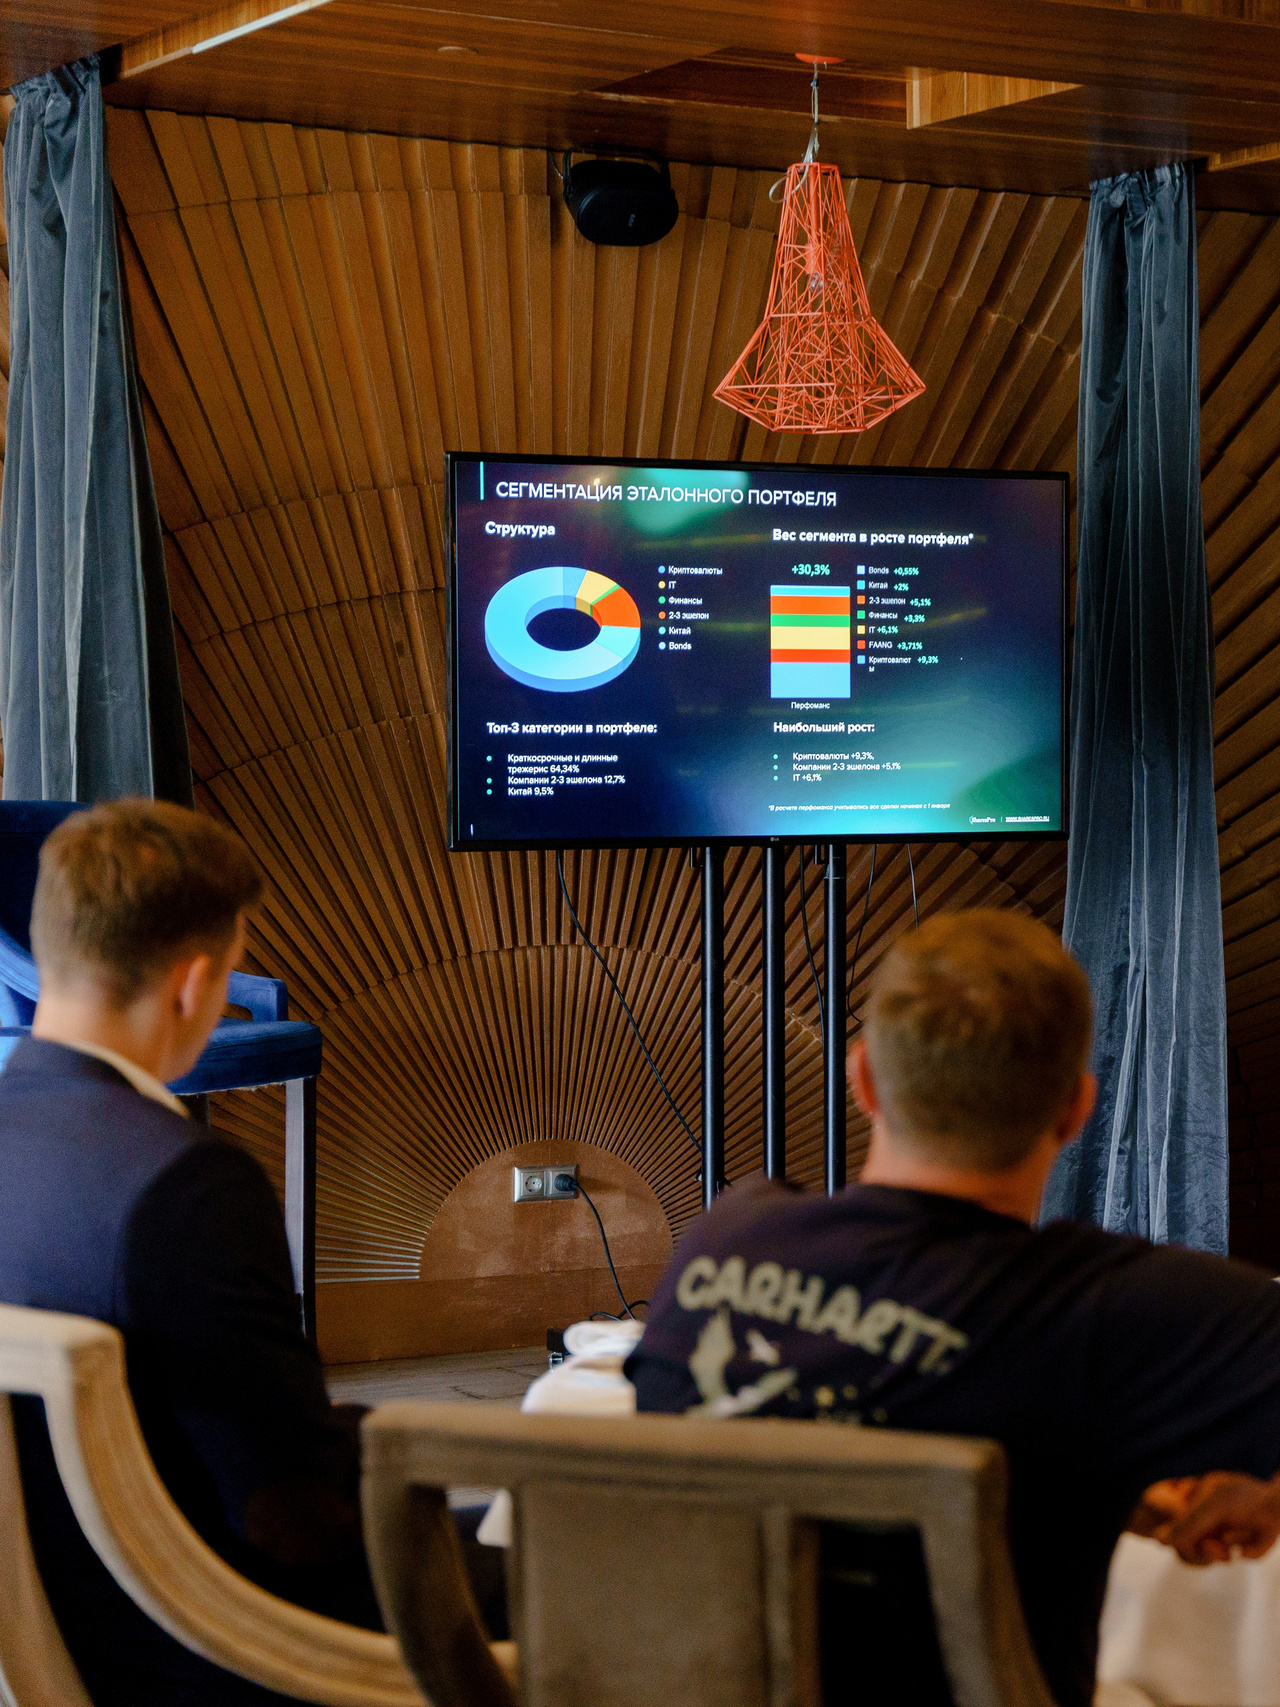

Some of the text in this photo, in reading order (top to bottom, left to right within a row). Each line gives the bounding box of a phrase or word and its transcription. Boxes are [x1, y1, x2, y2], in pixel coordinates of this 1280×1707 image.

[496, 481, 837, 506] СЕГМЕНТАЦИЯ ЭТАЛОННОГО ПОРТФЕЛЯ
[485, 521, 556, 538] Структура
[772, 528, 796, 541] Вес
[799, 531, 856, 543] сегмента
[859, 533, 867, 542] в
[870, 533, 905, 545] росте
[668, 565, 723, 576] Криптовалюты
[791, 564, 830, 577] +30,3%
[868, 566, 919, 576] Bonds +0,55%
[868, 581, 909, 591] Китай +2%
[668, 596, 703, 605] Финансы
[868, 596, 880, 605] 2-3
[910, 598, 931, 607] +5,1%
[668, 611, 681, 620] 2-3
[868, 611, 925, 623] Финансы +3,3%
[668, 626, 692, 635] Китай
[877, 625, 898, 635] +6,1%
[668, 641, 692, 651] Bonds
[868, 641, 923, 650] FAANG +3,71%
[868, 655, 939, 665] Криптовалют +9,3%
[790, 701, 831, 710] Перфоманс
[486, 722, 658, 736] Топ-3 категории в портфеле:
[773, 721, 875, 734] Наибольший рост:
[507, 753, 573, 764] Краткосрочные
[581, 754, 618, 764] длинные
[792, 752, 850, 762] Криптовалюты
[507, 765, 580, 775] трежерис 64,34%
[792, 762, 902, 772] Компании 2-3 эшелона +5,1%
[507, 775, 626, 785] Компании 2-3 эшелона 12,7%
[801, 773, 822, 783] +6,1%
[507, 787, 554, 797] Китай 9,5%
